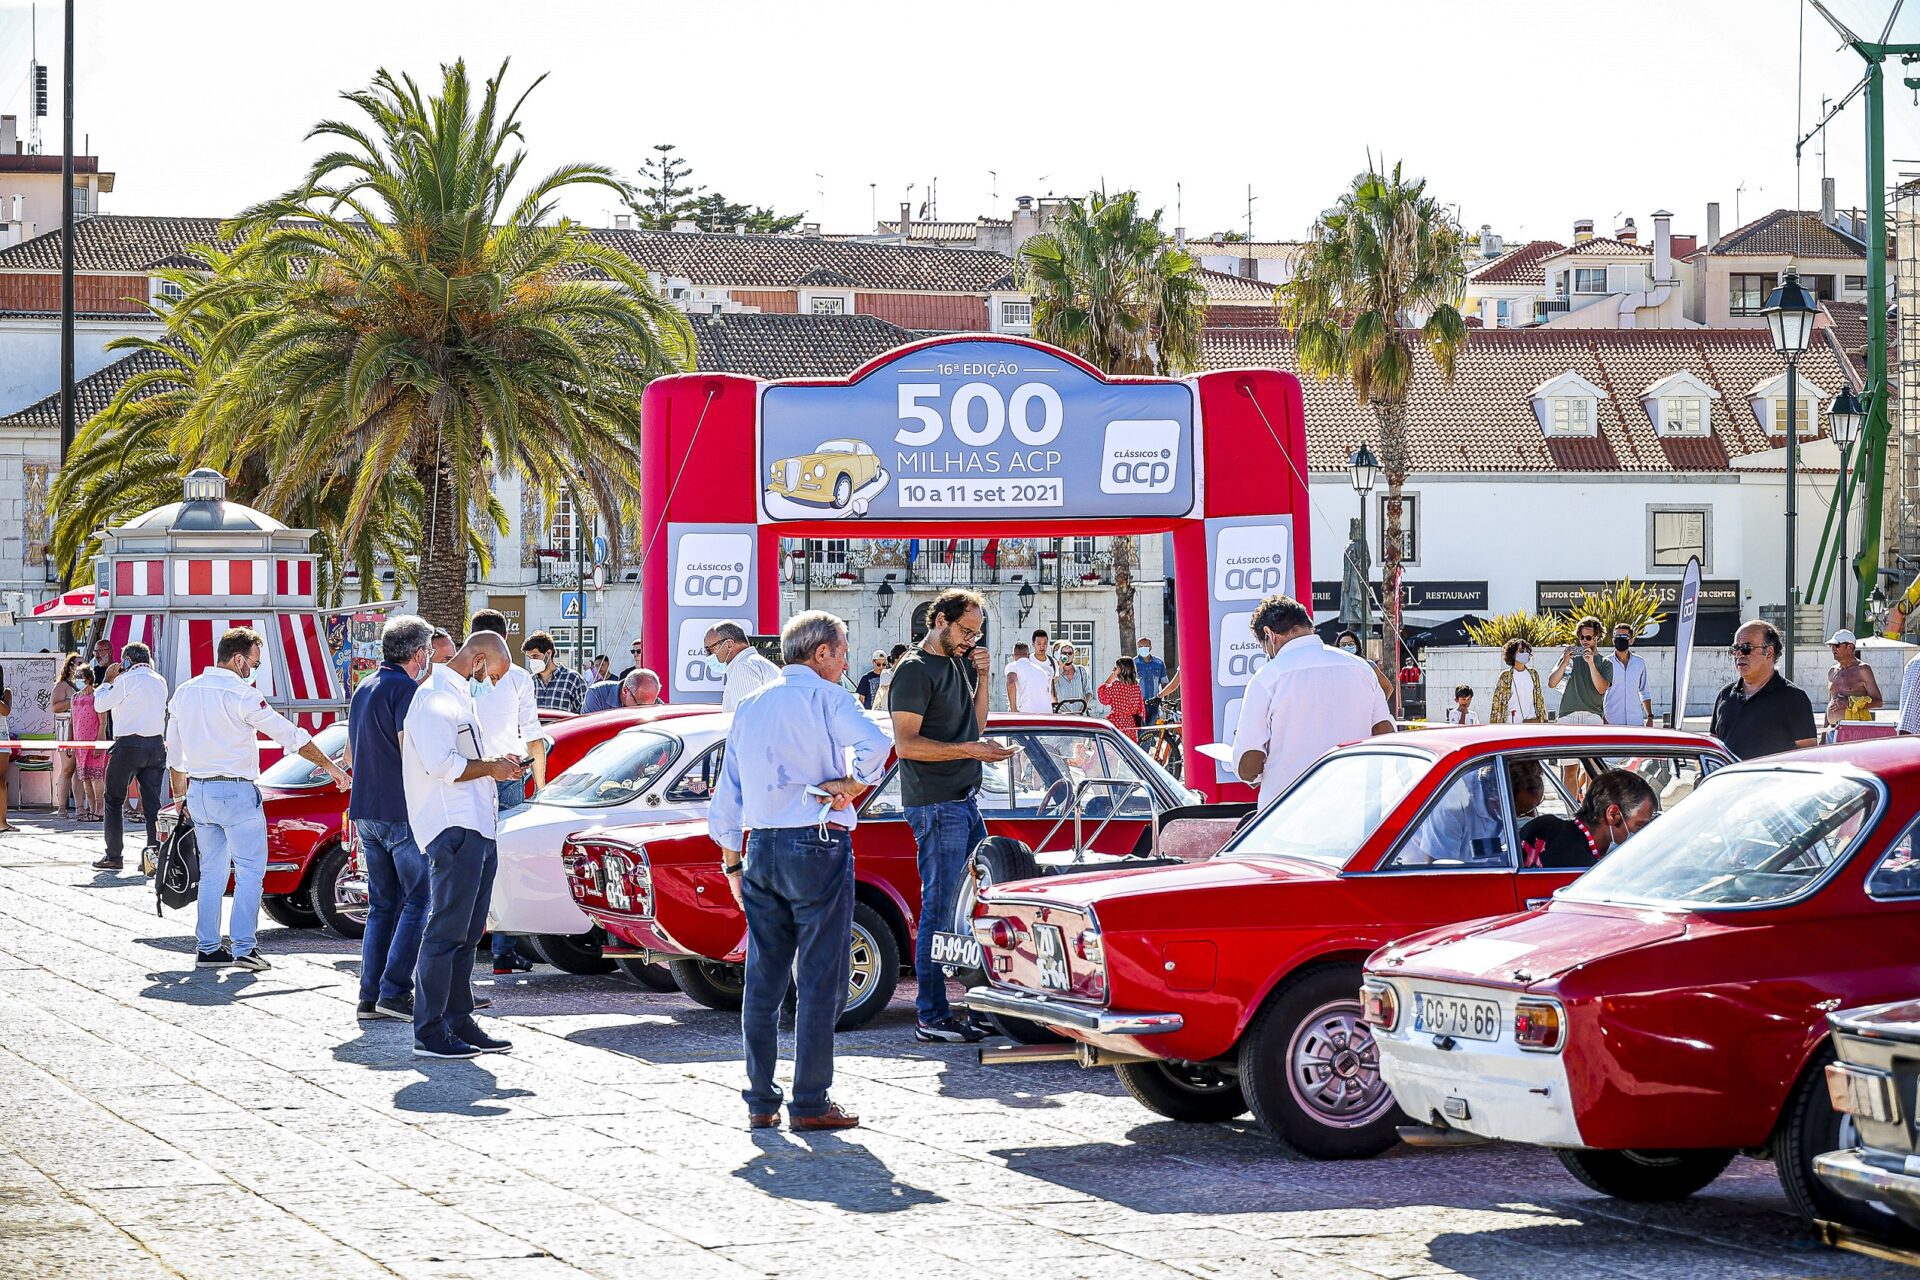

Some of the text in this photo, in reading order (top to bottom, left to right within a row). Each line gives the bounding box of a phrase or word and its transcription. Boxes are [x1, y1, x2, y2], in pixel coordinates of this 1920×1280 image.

[936, 361, 1018, 378] 16ª EDIÇÃO
[894, 382, 1065, 447] 500
[897, 451, 1062, 473] MILHAS ACP
[1114, 449, 1159, 458] CLÁSSICOS
[1112, 461, 1170, 488] acp
[904, 484, 1058, 502] 10 a 11 set 2021
[686, 563, 732, 571] CLÁSSICOS
[1226, 556, 1271, 565] CLÁSSICOS
[684, 574, 743, 601] acp
[1225, 567, 1281, 593] acp
[1425, 592, 1481, 600] RESTAURANT
[1541, 591, 1568, 599] VISITOR
[1229, 653, 1268, 676] ac
